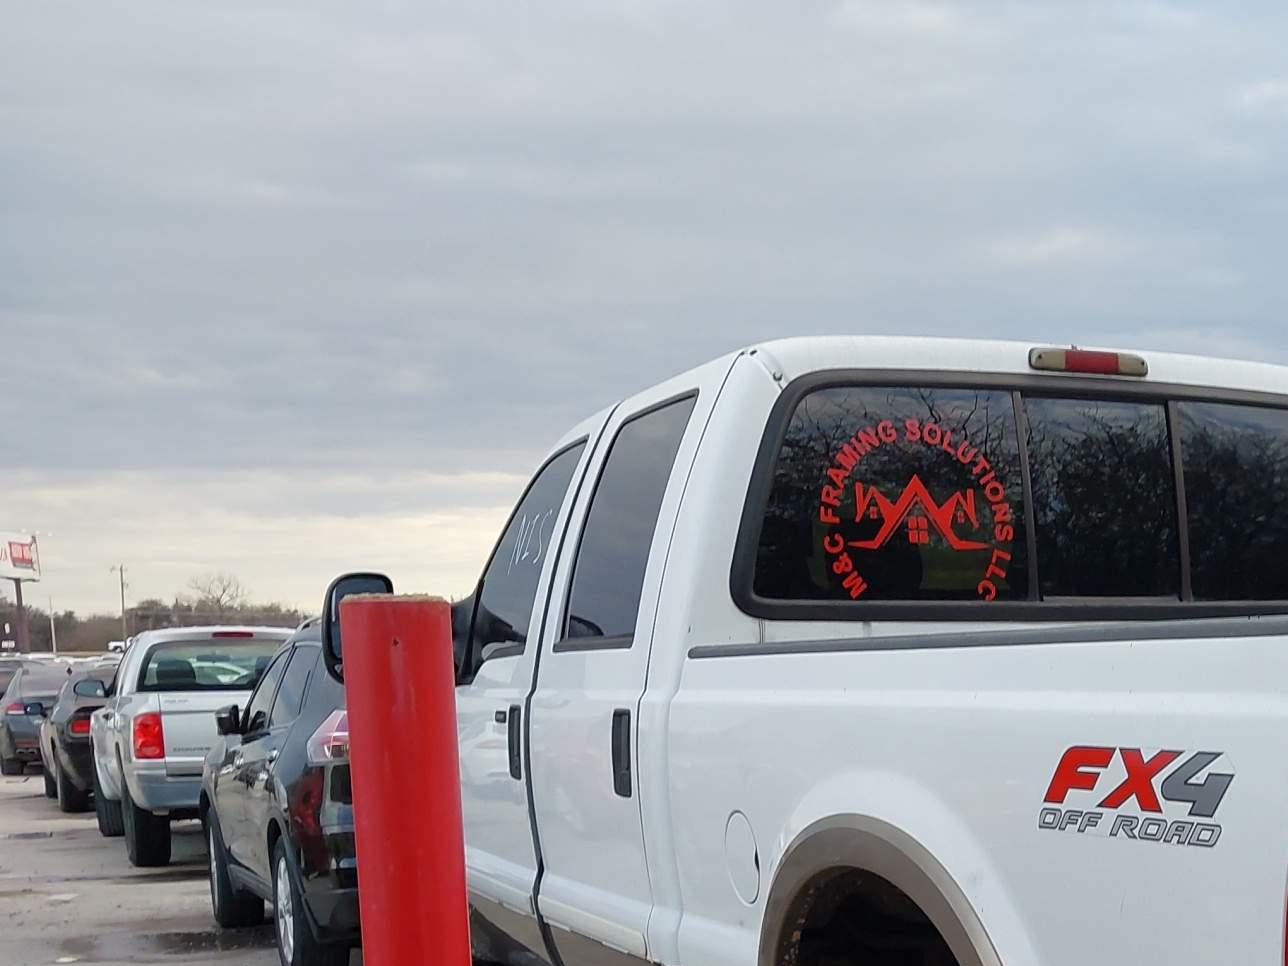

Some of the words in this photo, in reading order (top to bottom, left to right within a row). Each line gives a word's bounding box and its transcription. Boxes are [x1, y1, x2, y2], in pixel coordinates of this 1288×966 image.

[818, 418, 898, 525] FRAMING
[904, 417, 1015, 542] SOLUTIONS
[822, 531, 868, 600] M&C
[977, 548, 1013, 602] LLC
[1043, 745, 1235, 817] FX4
[1038, 807, 1104, 832] OFF
[1109, 814, 1223, 848] ROAD
